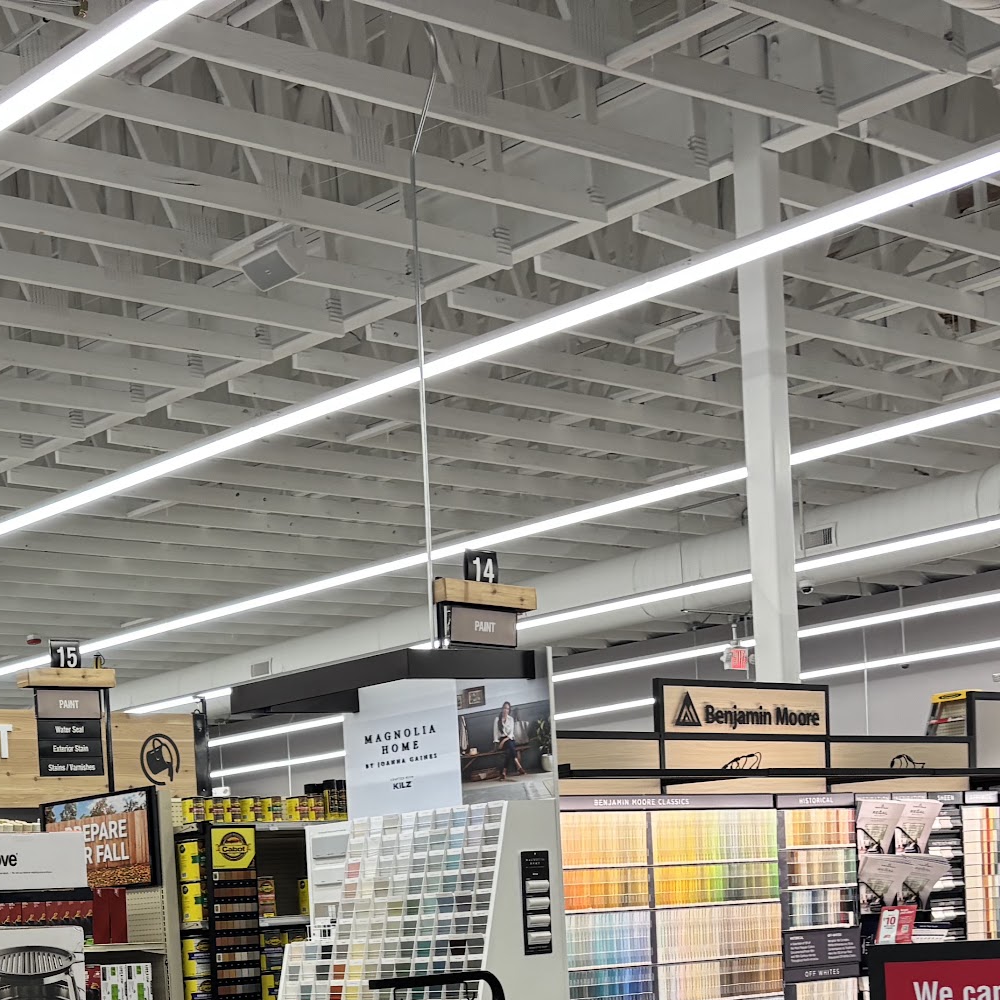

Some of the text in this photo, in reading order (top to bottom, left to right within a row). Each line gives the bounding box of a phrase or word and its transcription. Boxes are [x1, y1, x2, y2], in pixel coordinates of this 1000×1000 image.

[472, 557, 495, 583] 14
[474, 620, 496, 633] PAINT
[56, 646, 78, 668] 15
[59, 699, 79, 709] PAINT
[704, 704, 820, 729] Benjamin Moore
[54, 725, 84, 734] Water Seal
[364, 724, 436, 745] MAGNOLIA
[52, 744, 89, 753] Exterior Stain
[381, 740, 419, 755] HOME
[48, 763, 96, 772] Stains Varnishes
[392, 780, 413, 790] KILZ
[631, 798, 656, 806] MOORE
[657, 798, 690, 806] CLASSICS
[798, 796, 833, 805] HISTORICAL
[96, 842, 130, 863] FALL
[804, 968, 841, 978] OFF WHITES
